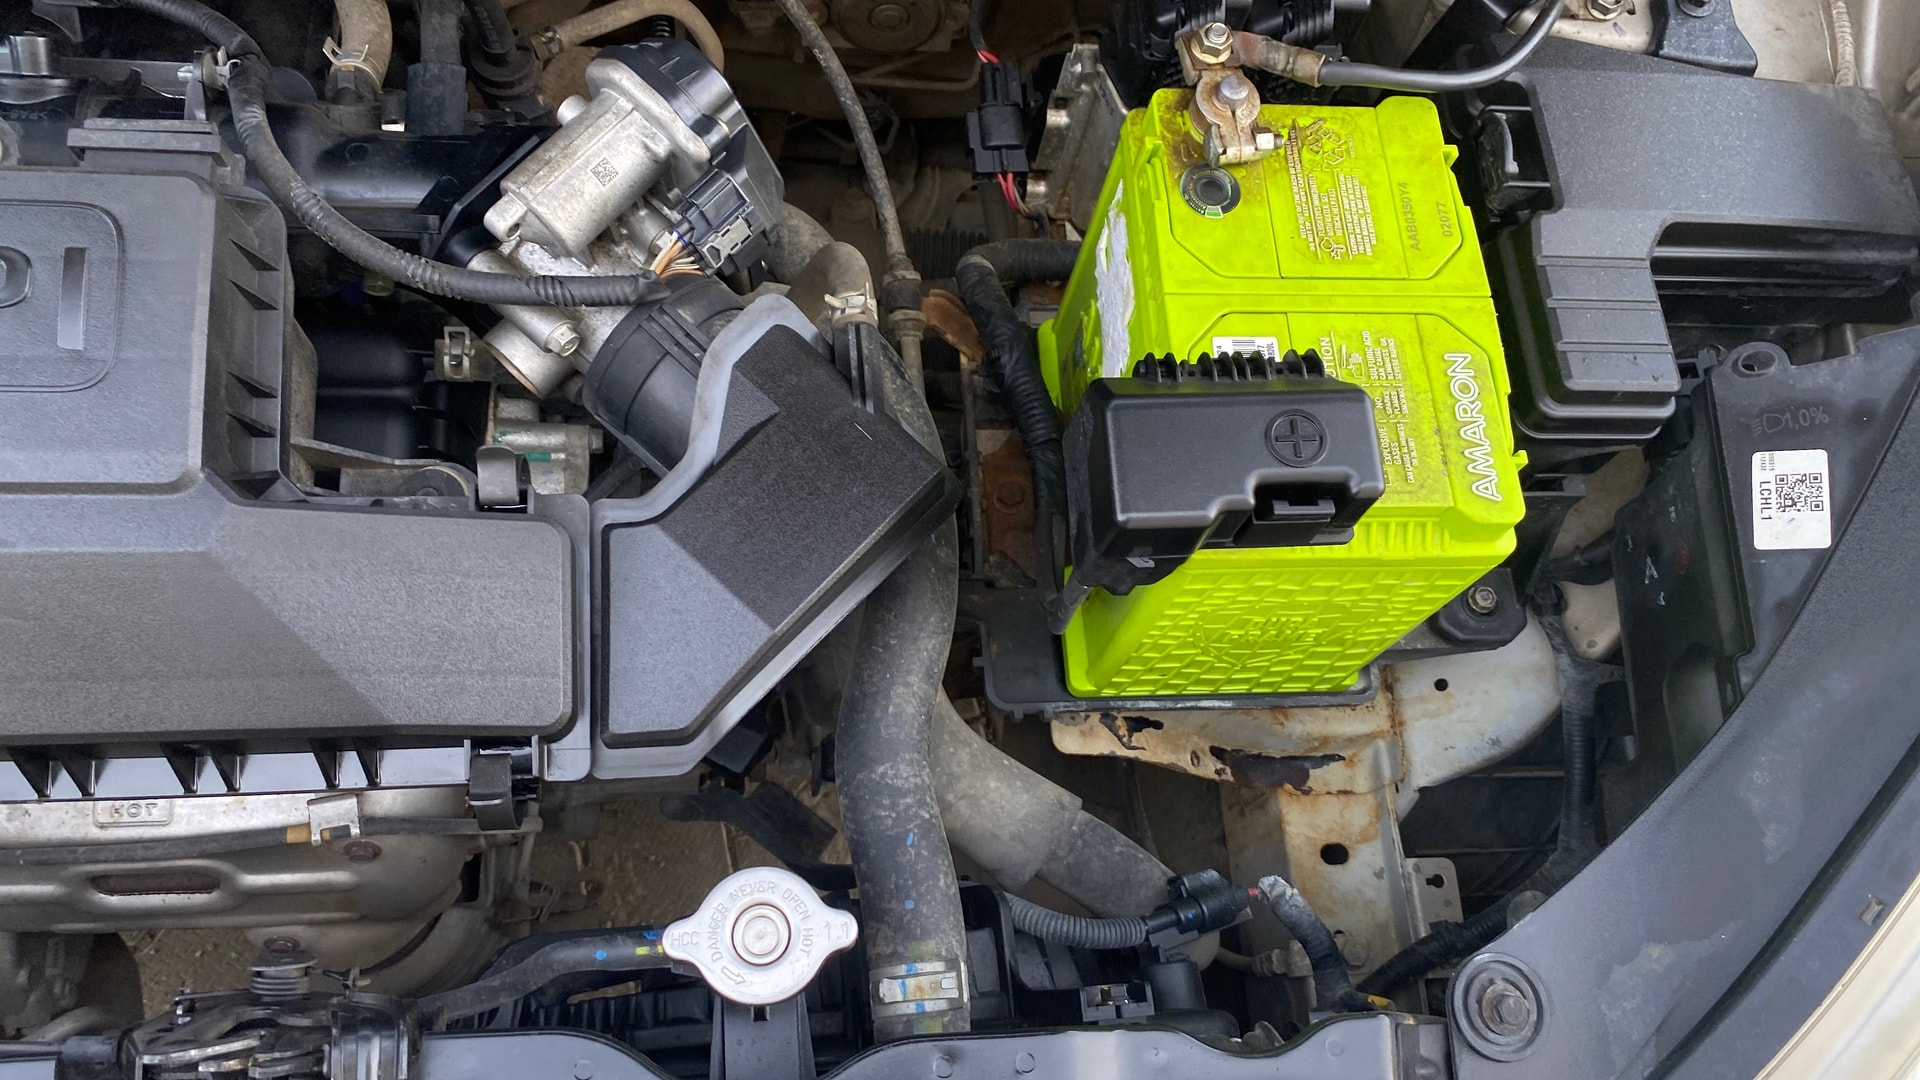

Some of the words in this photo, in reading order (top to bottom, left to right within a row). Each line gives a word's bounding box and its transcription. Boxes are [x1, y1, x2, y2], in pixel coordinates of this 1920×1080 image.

[1398, 181, 1421, 251] AAB0350Y4
[1436, 201, 1453, 237] 02077
[1362, 331, 1371, 345] ACID
[1381, 338, 1388, 346] OR
[1389, 338, 1398, 357] BURNS
[1321, 337, 1336, 377] UTION
[1366, 348, 1378, 380] SULFURIC
[1374, 347, 1383, 366] CAUSE
[1383, 349, 1394, 380] BLINDNESS
[1393, 359, 1402, 380] SEVERE
[1375, 397, 1383, 409] NO
[1384, 390, 1393, 415] SPARKS
[1391, 391, 1401, 414] FLAMES
[1399, 387, 1408, 414] SMOKING
[1397, 423, 1407, 452] BLINDNESS
[1444, 353, 1502, 501] AMARON
[1378, 427, 1392, 464] EXPLOSIVE
[1391, 442, 1402, 464] GASES
[1408, 437, 1417, 457] INJURY
[1403, 454, 1412, 471] CAUSE
[1412, 458, 1419, 466] OR
[1407, 472, 1415, 483] CAN
[1760, 481, 1772, 520] LCHL1
[706, 902, 729, 962] DANGER
[729, 880, 776, 903] NEVER
[782, 888, 811, 921] OPEN
[800, 927, 814, 958] HOT
[824, 921, 849, 940] 1.1
[671, 931, 700, 947] HCC
